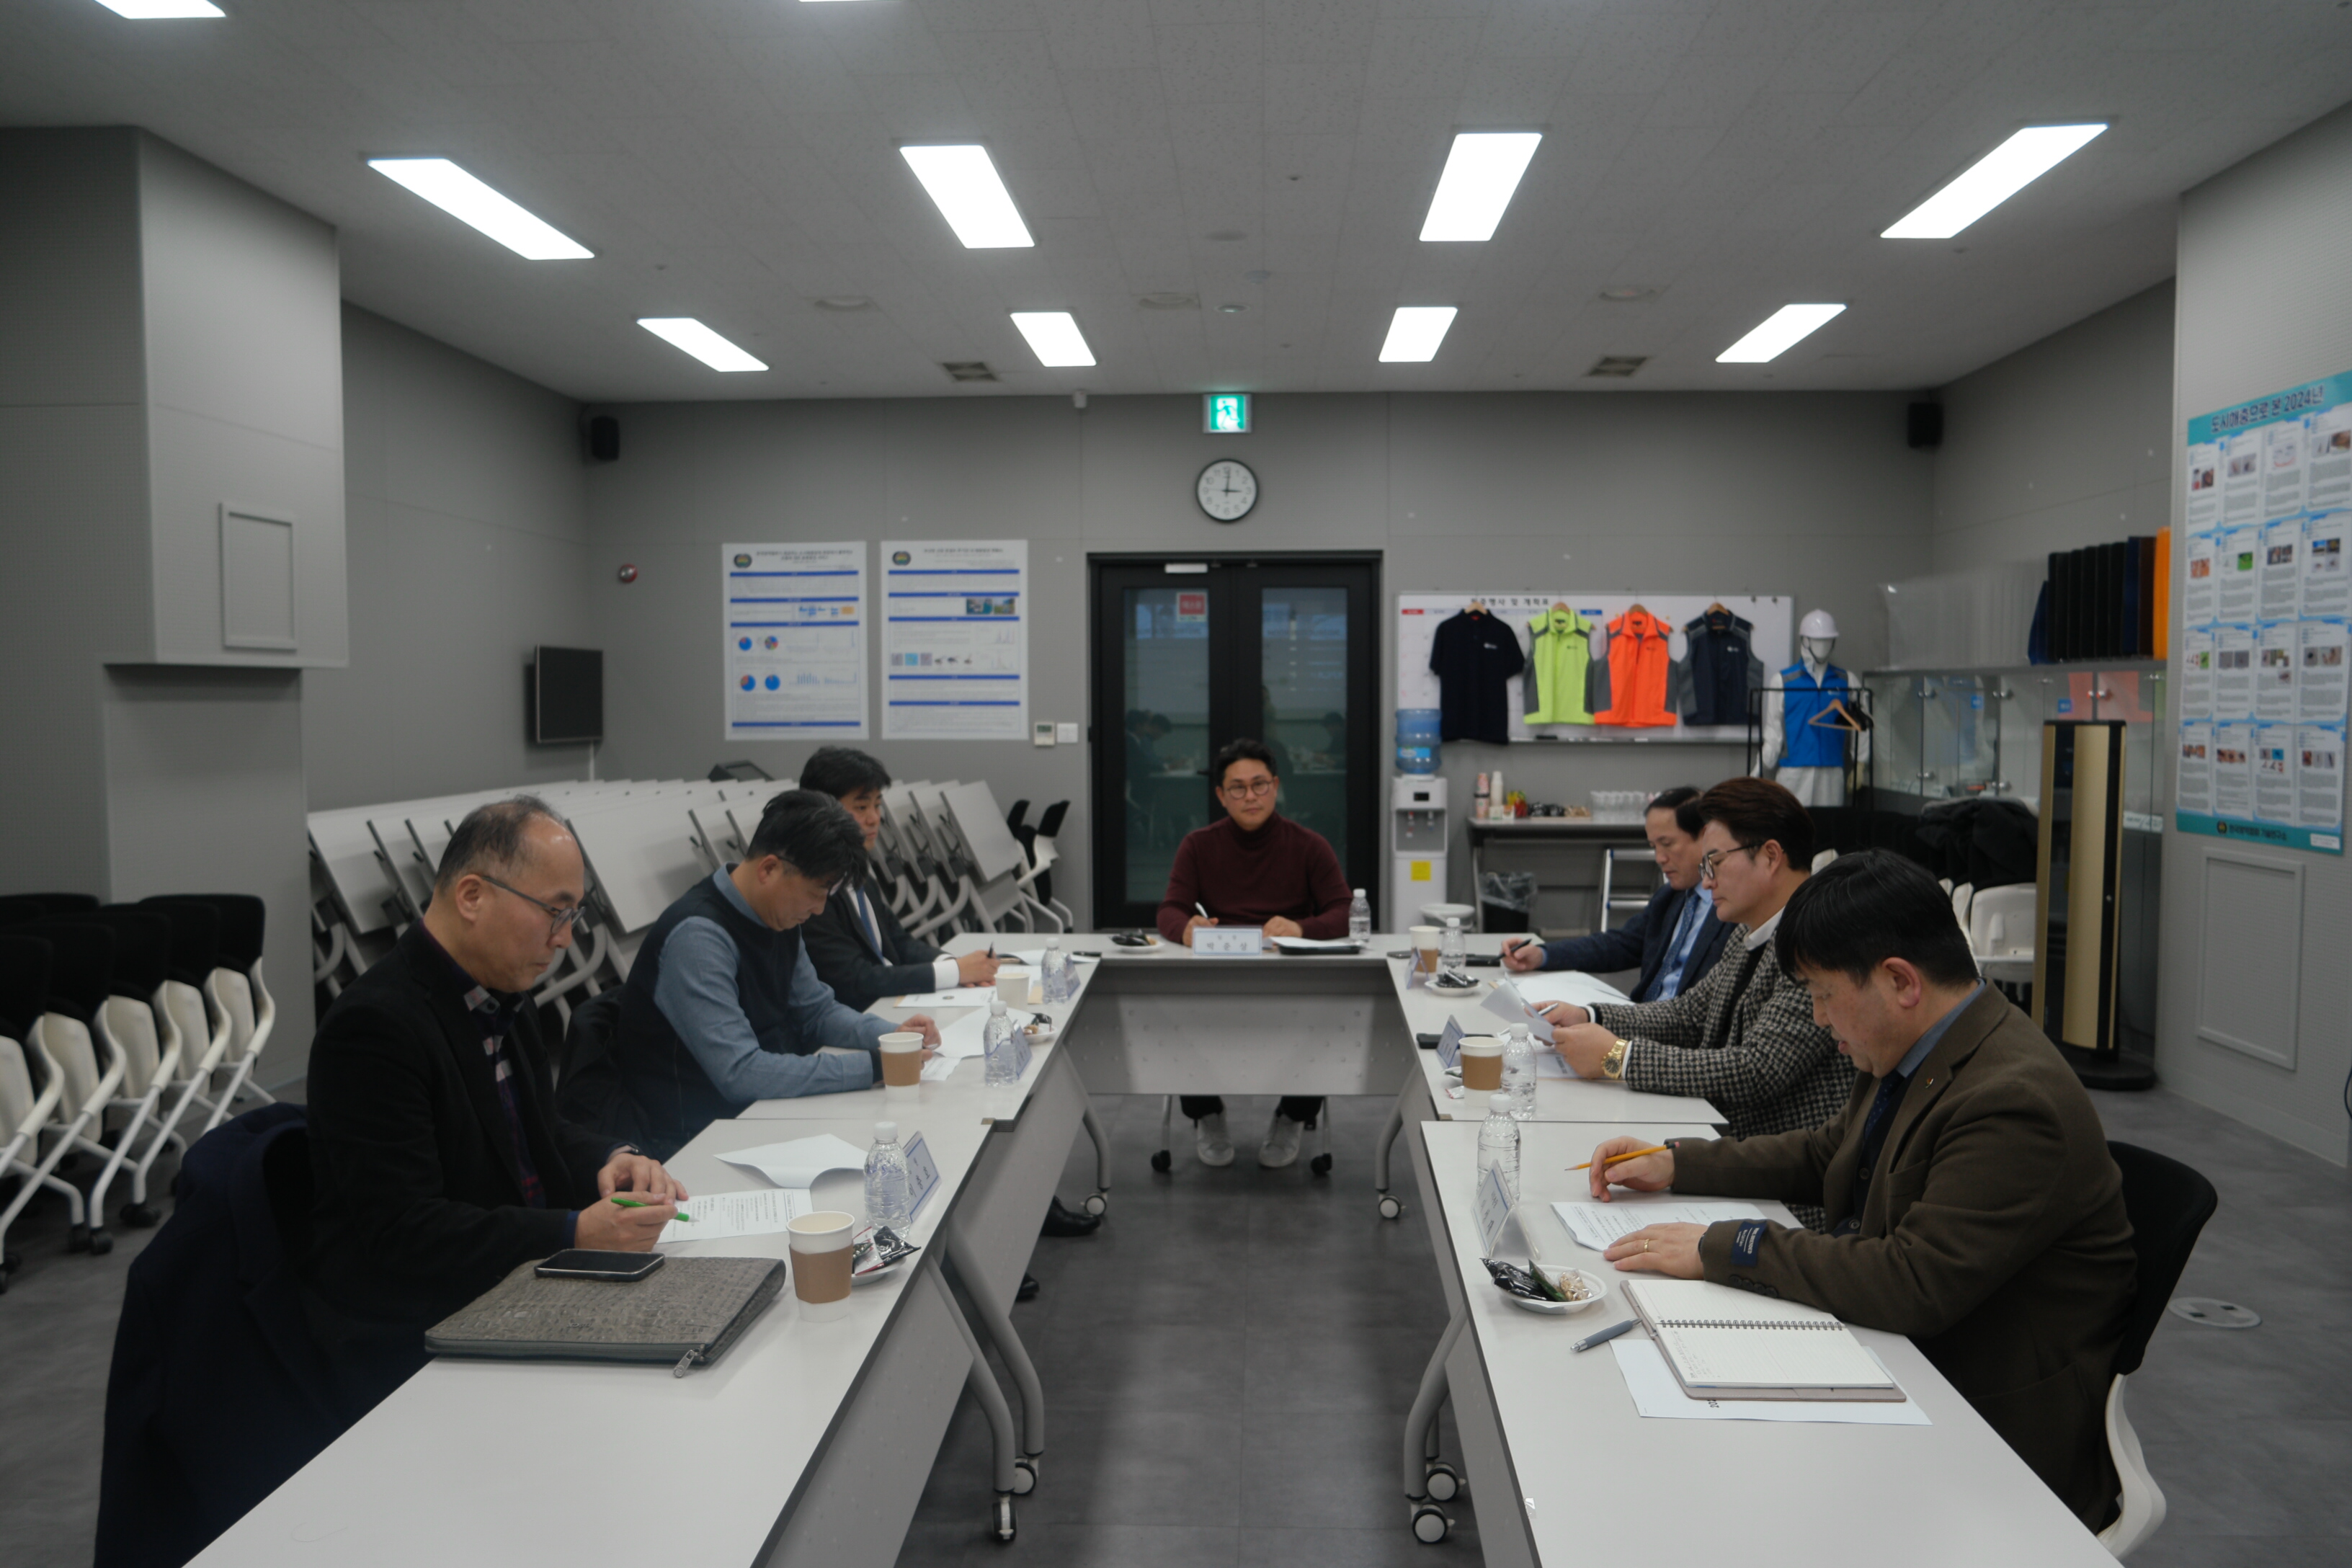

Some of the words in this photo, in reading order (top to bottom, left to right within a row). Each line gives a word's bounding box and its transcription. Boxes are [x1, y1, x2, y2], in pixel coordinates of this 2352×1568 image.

[2211, 400, 2268, 432] 도시해충으로
[2271, 396, 2281, 416] 본
[2284, 384, 2324, 412] 2024년
